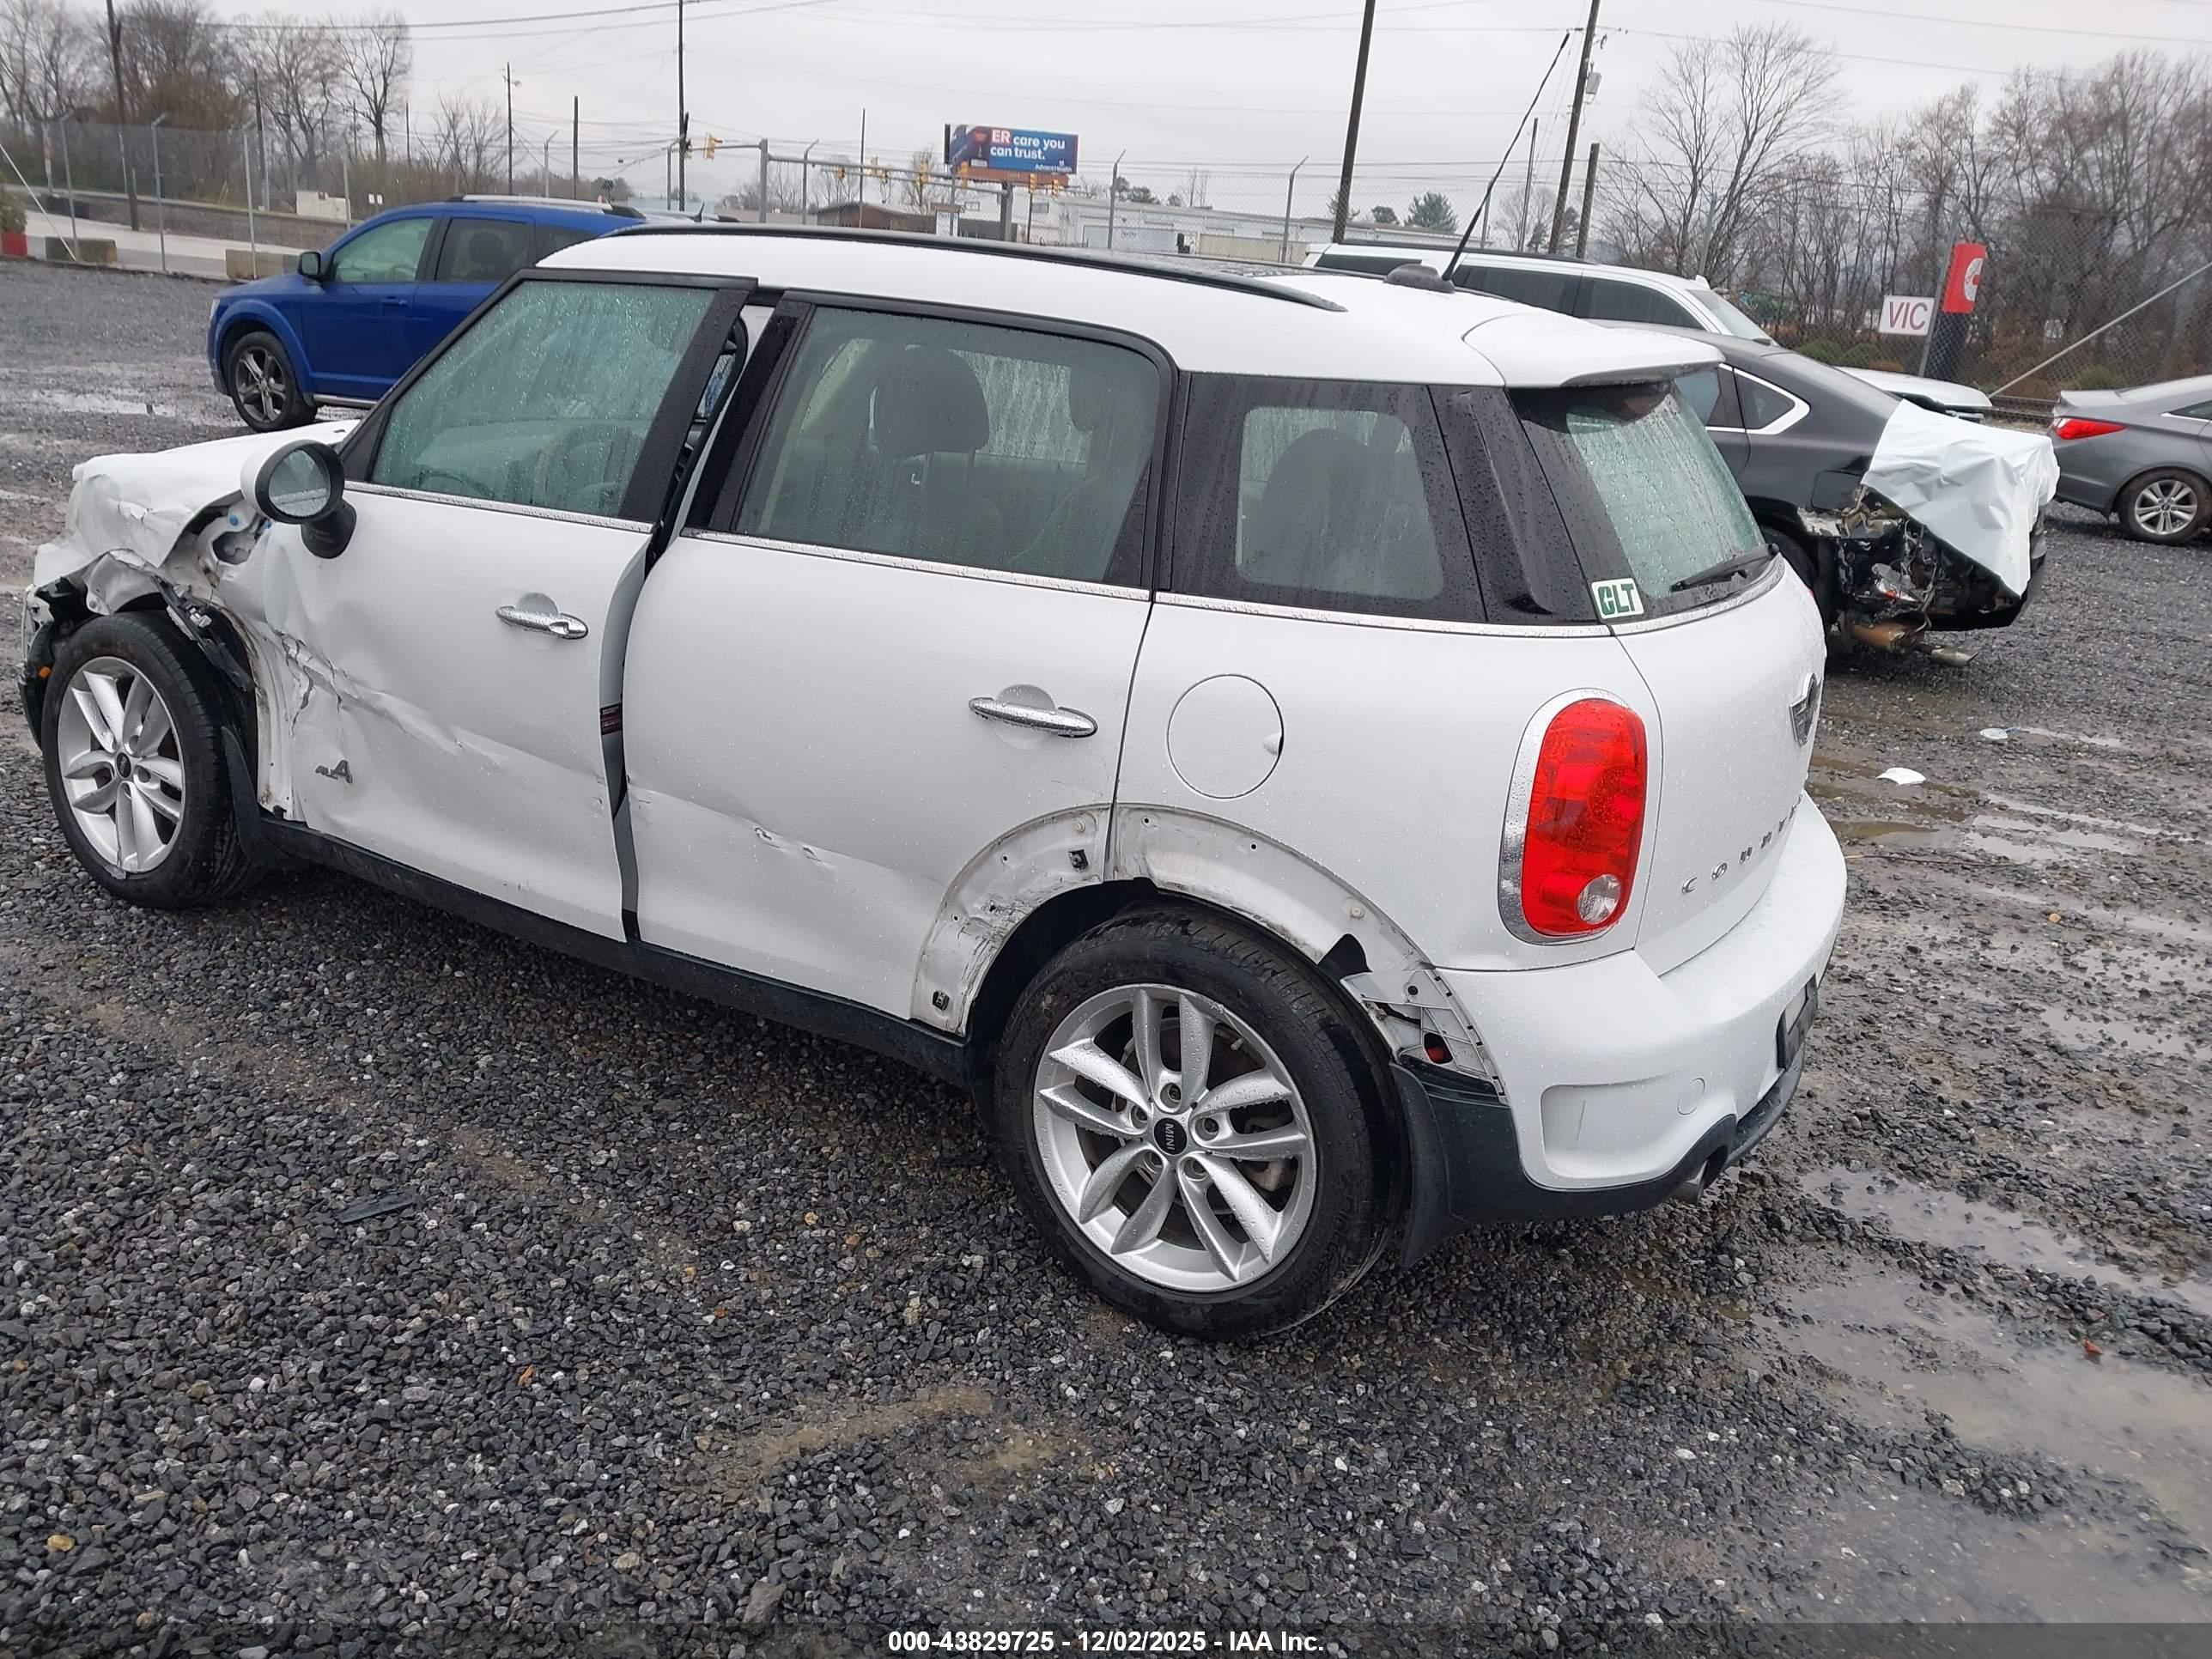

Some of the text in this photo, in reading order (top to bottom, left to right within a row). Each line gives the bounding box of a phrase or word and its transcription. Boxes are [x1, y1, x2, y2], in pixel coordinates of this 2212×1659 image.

[990, 145, 1046, 160] can trust.
[992, 129, 1066, 150] ER care you
[1889, 301, 1929, 331] VIC
[1598, 583, 1635, 616] CLT
[1164, 1122, 1176, 1151] MINI
